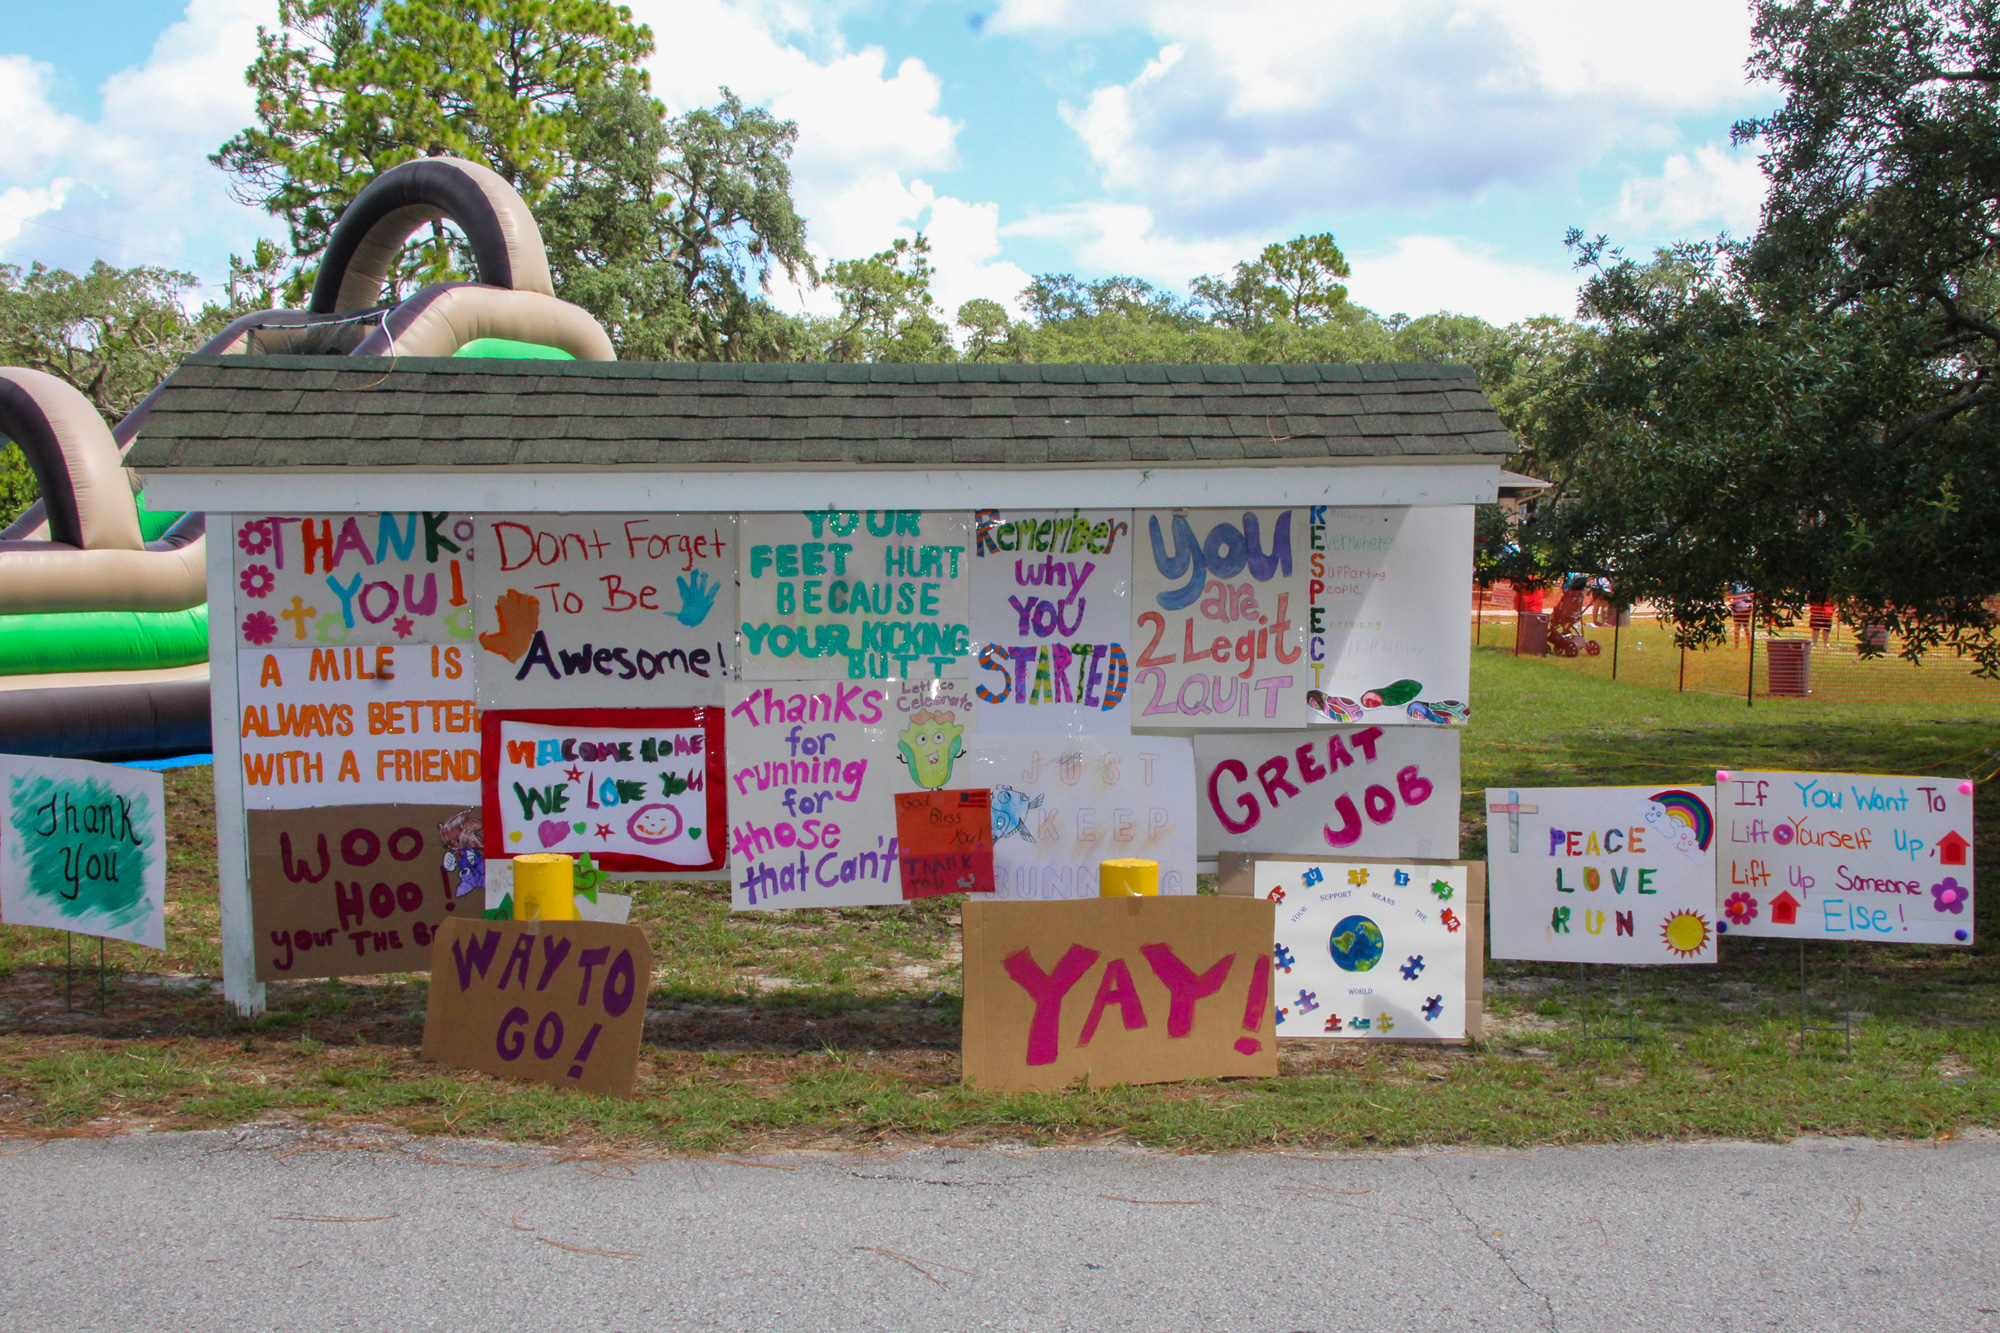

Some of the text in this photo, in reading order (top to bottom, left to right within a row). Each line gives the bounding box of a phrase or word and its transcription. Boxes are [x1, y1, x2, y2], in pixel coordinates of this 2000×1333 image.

[258, 511, 461, 575] THANK
[803, 510, 921, 539] YOUR
[975, 508, 1128, 557] Remember
[624, 519, 726, 571] Forget
[751, 542, 965, 579] FEET HURT
[326, 560, 468, 628] YOU!
[535, 575, 659, 614] To Be
[776, 580, 940, 616] BECAUSE
[1015, 555, 1095, 604] why
[1008, 595, 1086, 638] YOU
[1200, 580, 1259, 623] are
[741, 621, 970, 658] YOUR KICKING
[1136, 592, 1302, 679] 2 Legit
[260, 645, 463, 687] A MILE IS
[515, 630, 728, 681] Awesome!
[848, 648, 956, 679] BUTT
[975, 642, 1129, 711] STARTED
[242, 700, 481, 738] ALWAYS BETTER
[506, 734, 705, 769] WELCOME HOME
[785, 725, 836, 757] for
[244, 749, 482, 785] WITH A FRIEND
[732, 756, 868, 802] running
[1022, 751, 1160, 786] JUST
[1207, 726, 1385, 834] GREAT
[513, 781, 570, 821] WE
[587, 771, 648, 810] LOVE
[782, 788, 833, 817] for
[1323, 764, 1434, 848] JOB
[1731, 780, 1946, 813] If You Want To
[36, 792, 143, 846] Thank
[929, 808, 962, 824] Bless
[1038, 808, 1169, 842] KEEP
[1731, 819, 1770, 844] Lift
[1787, 816, 1872, 850] Yourself
[280, 827, 423, 883] WOO
[731, 819, 840, 863] those
[1549, 826, 1646, 857] PEACE
[740, 850, 809, 905] that
[1556, 866, 1658, 895] LOVE
[1732, 860, 1922, 899] Lift Up Someone
[1291, 890, 1428, 923] YOUR SUPPORT MEANS THE
[1551, 906, 1634, 937] RUN
[1823, 899, 1909, 933] Else!
[348, 930, 403, 957] THE
[452, 928, 635, 1017] WAY TO
[1001, 942, 1270, 1066] YAY!
